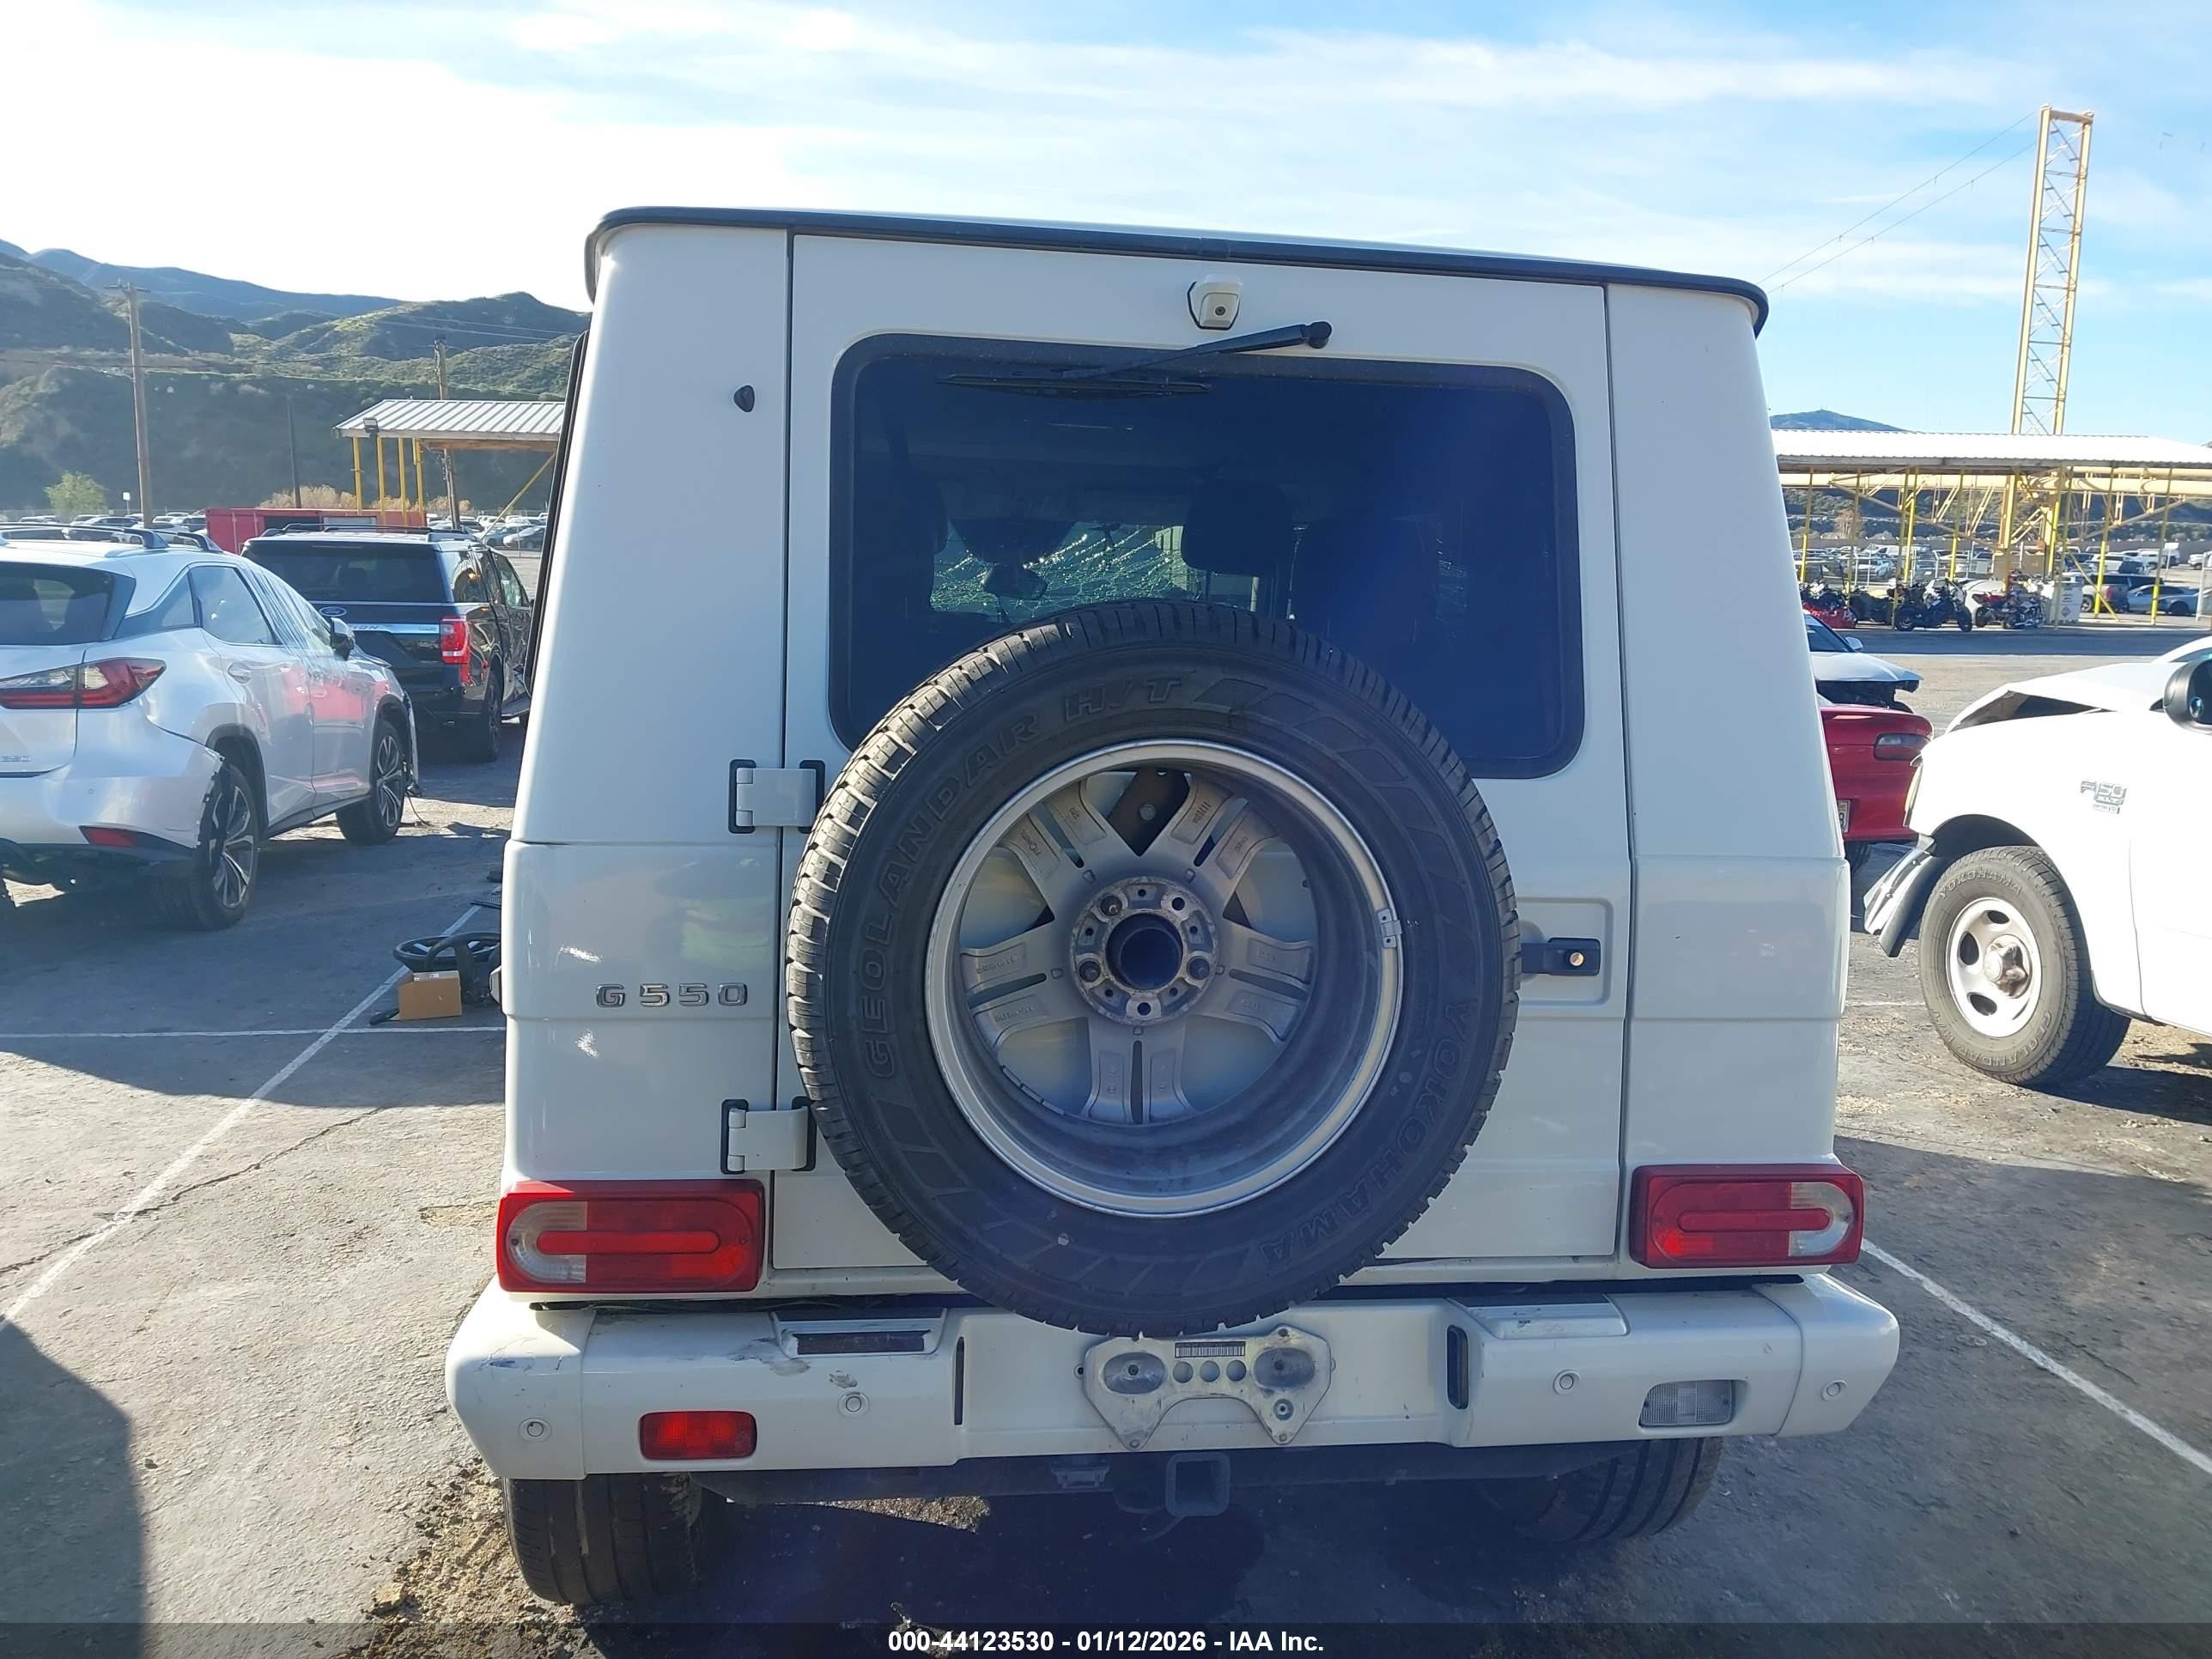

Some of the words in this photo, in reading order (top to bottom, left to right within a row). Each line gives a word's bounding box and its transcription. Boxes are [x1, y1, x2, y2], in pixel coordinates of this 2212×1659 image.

[862, 709, 1042, 1080] GEOLANDAR
[1063, 678, 1183, 721] H/T
[1938, 866, 2023, 899] YOKOHAMA
[1259, 996, 1479, 1265] YOKOHAMA
